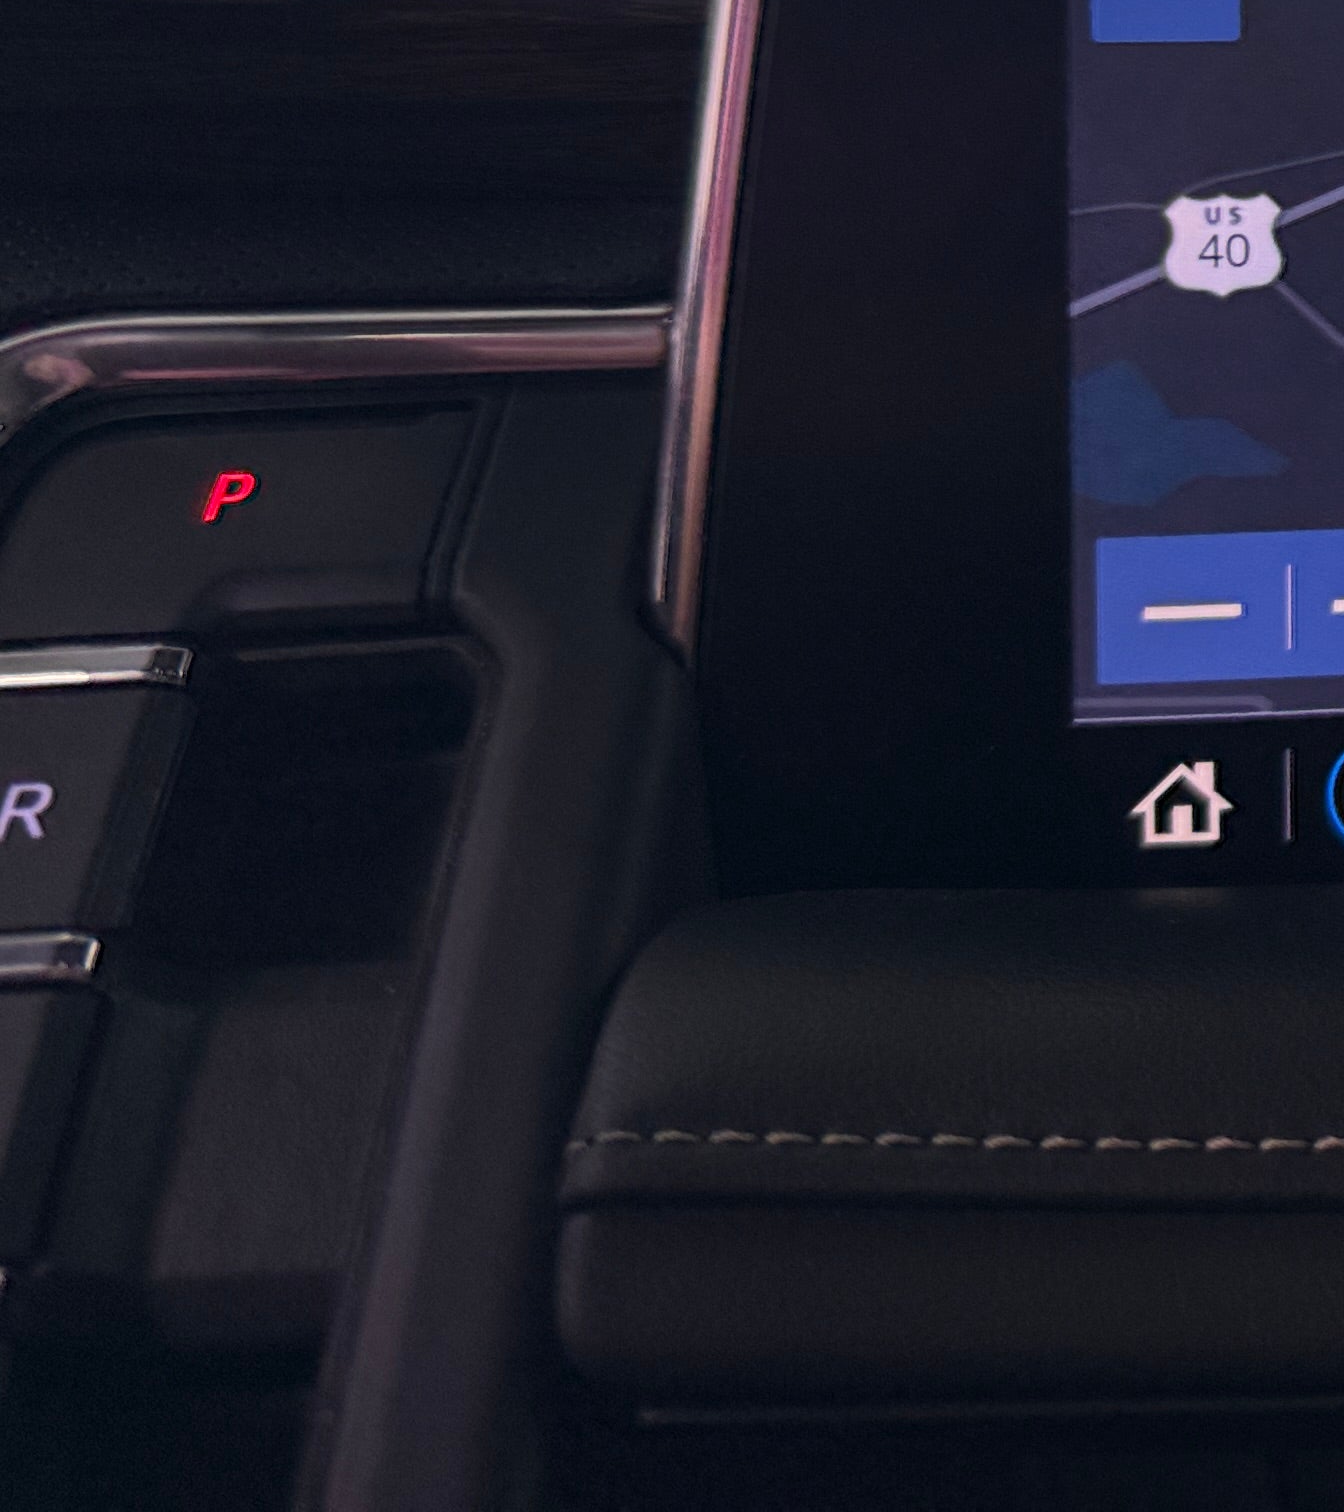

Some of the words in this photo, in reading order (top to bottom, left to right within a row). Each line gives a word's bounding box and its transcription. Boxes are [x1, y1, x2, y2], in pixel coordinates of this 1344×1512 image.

[1204, 206, 1243, 226] US
[1198, 233, 1251, 268] 40
[201, 470, 256, 524] P
[0, 782, 53, 842] R
